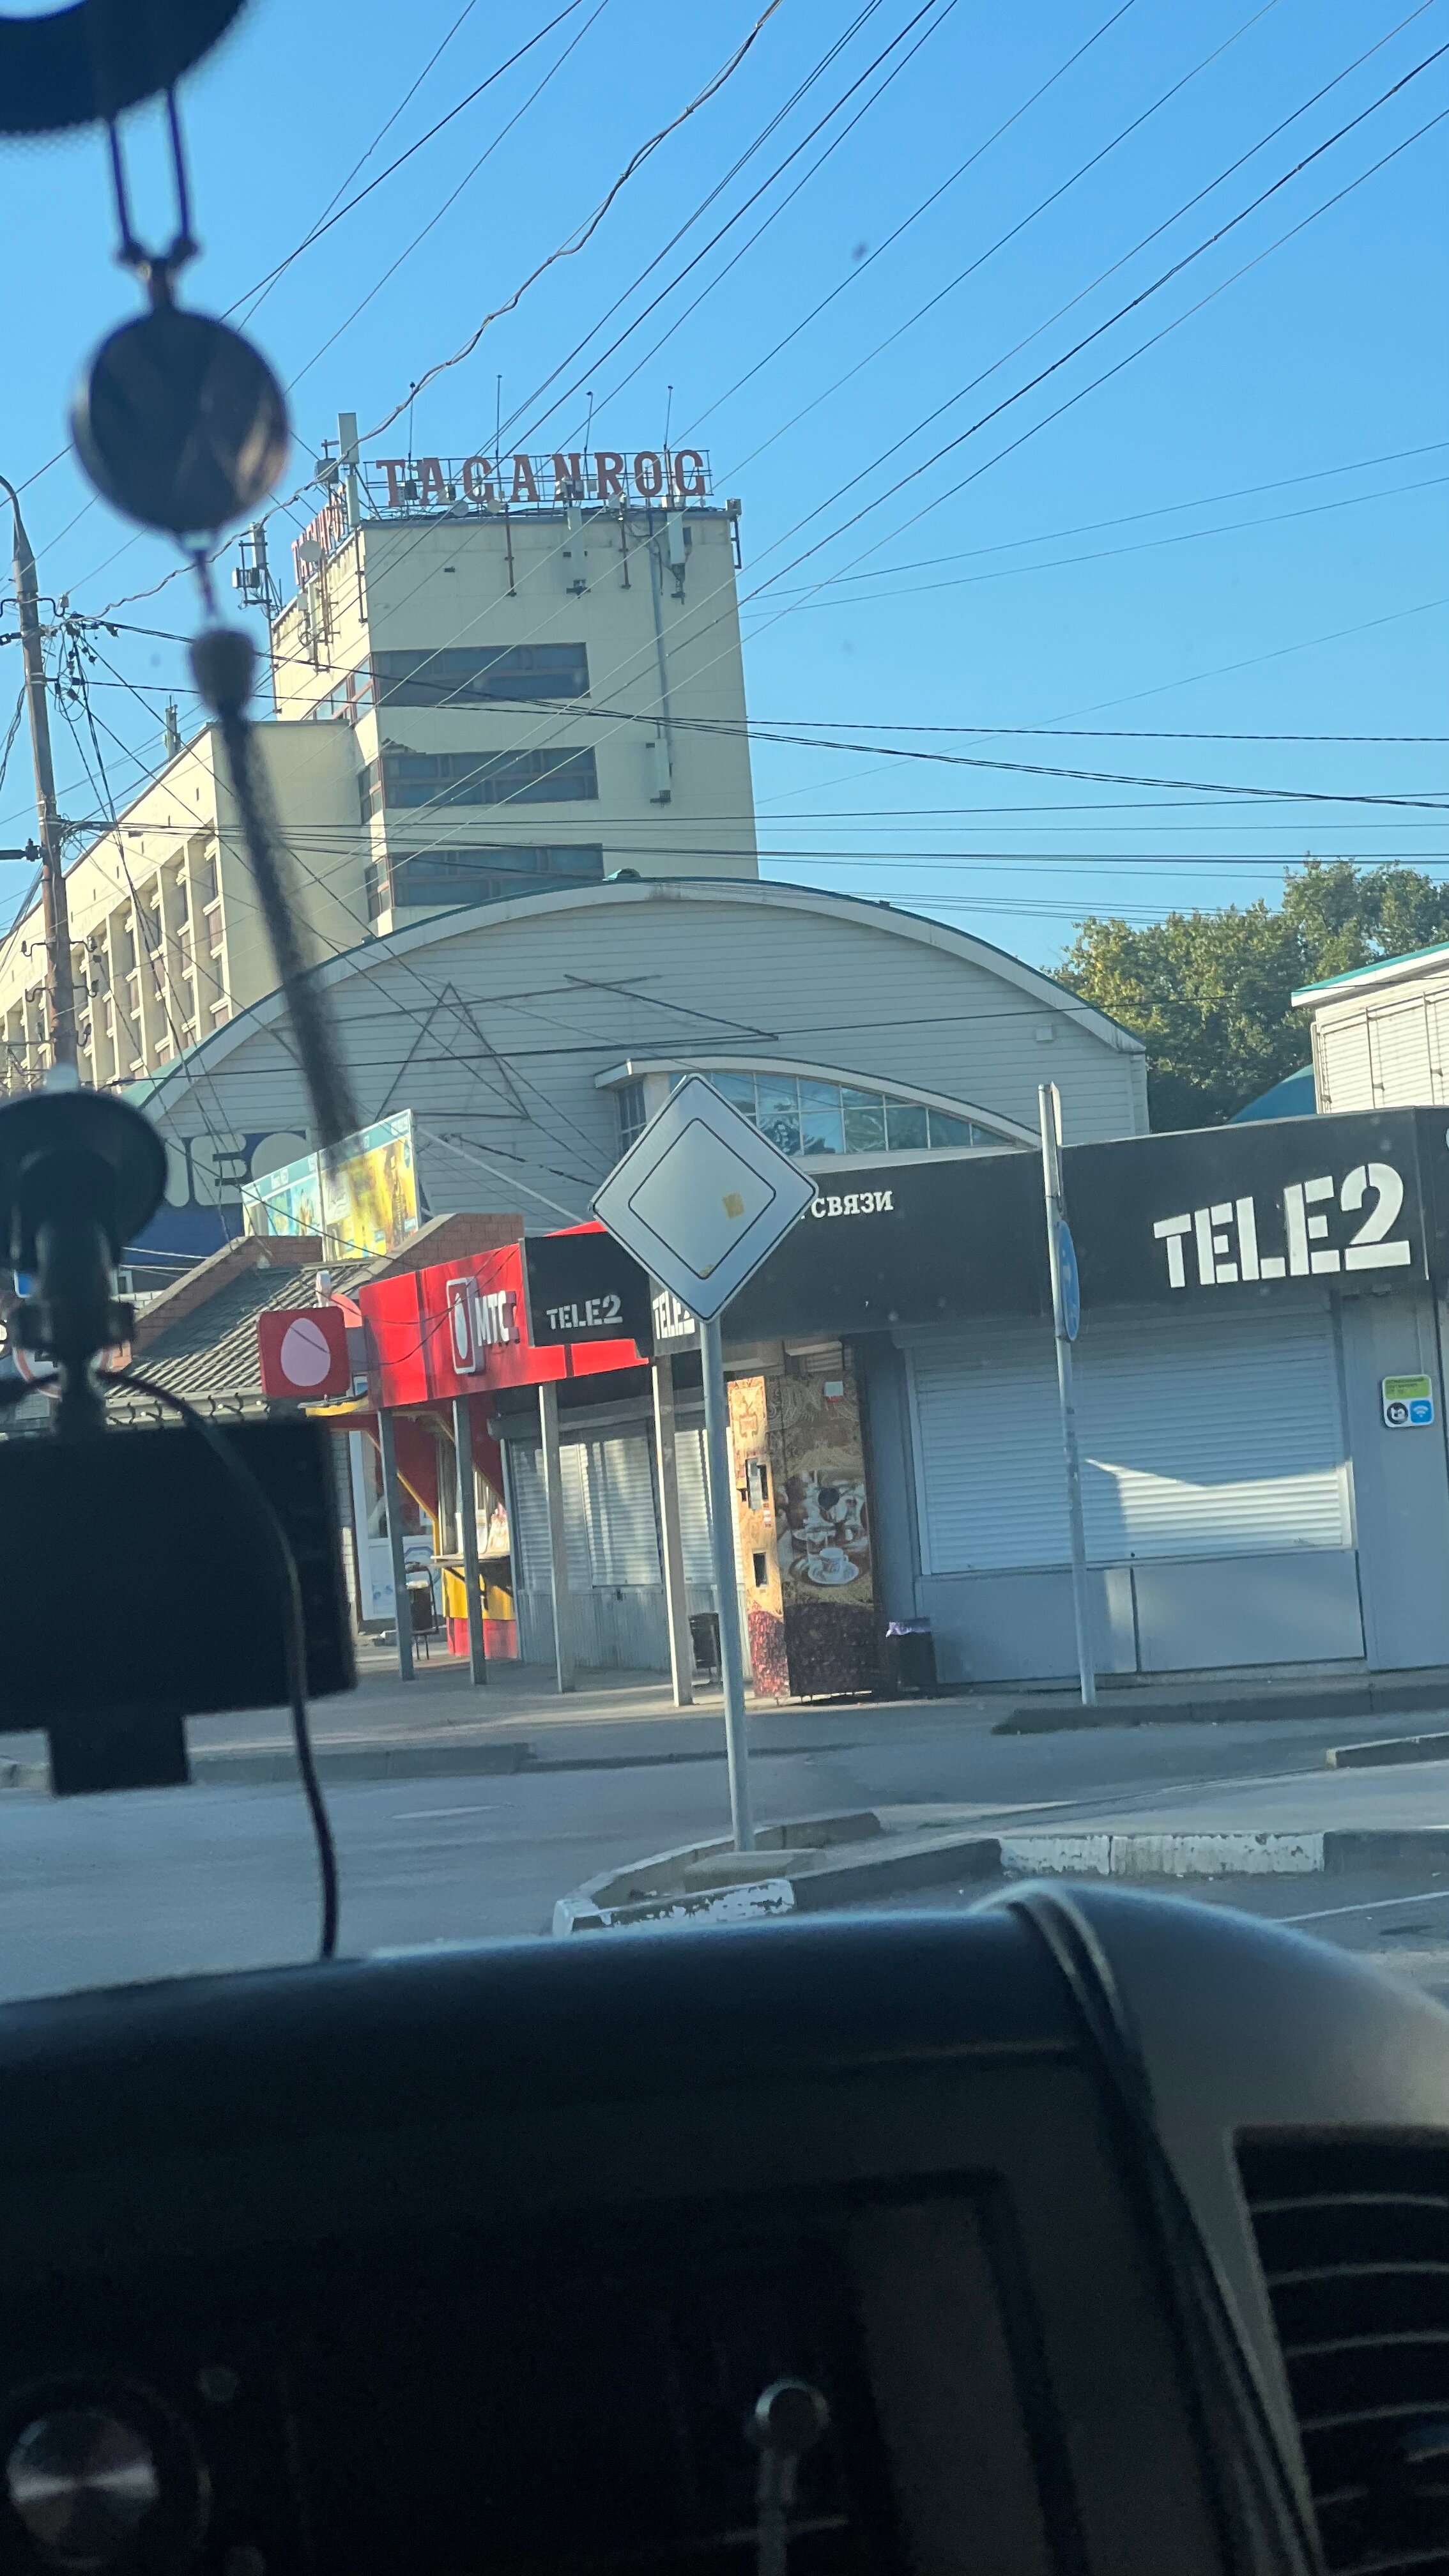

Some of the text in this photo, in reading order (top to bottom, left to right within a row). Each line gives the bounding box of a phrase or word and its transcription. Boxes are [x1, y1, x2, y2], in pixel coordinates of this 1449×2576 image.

[376, 450, 704, 507] TAGANROG
[811, 1190, 894, 1218] СВЯЗИ
[1153, 1163, 1411, 1288] TELE2
[474, 1290, 511, 1346] МТС
[546, 1294, 623, 1330] TELE2
